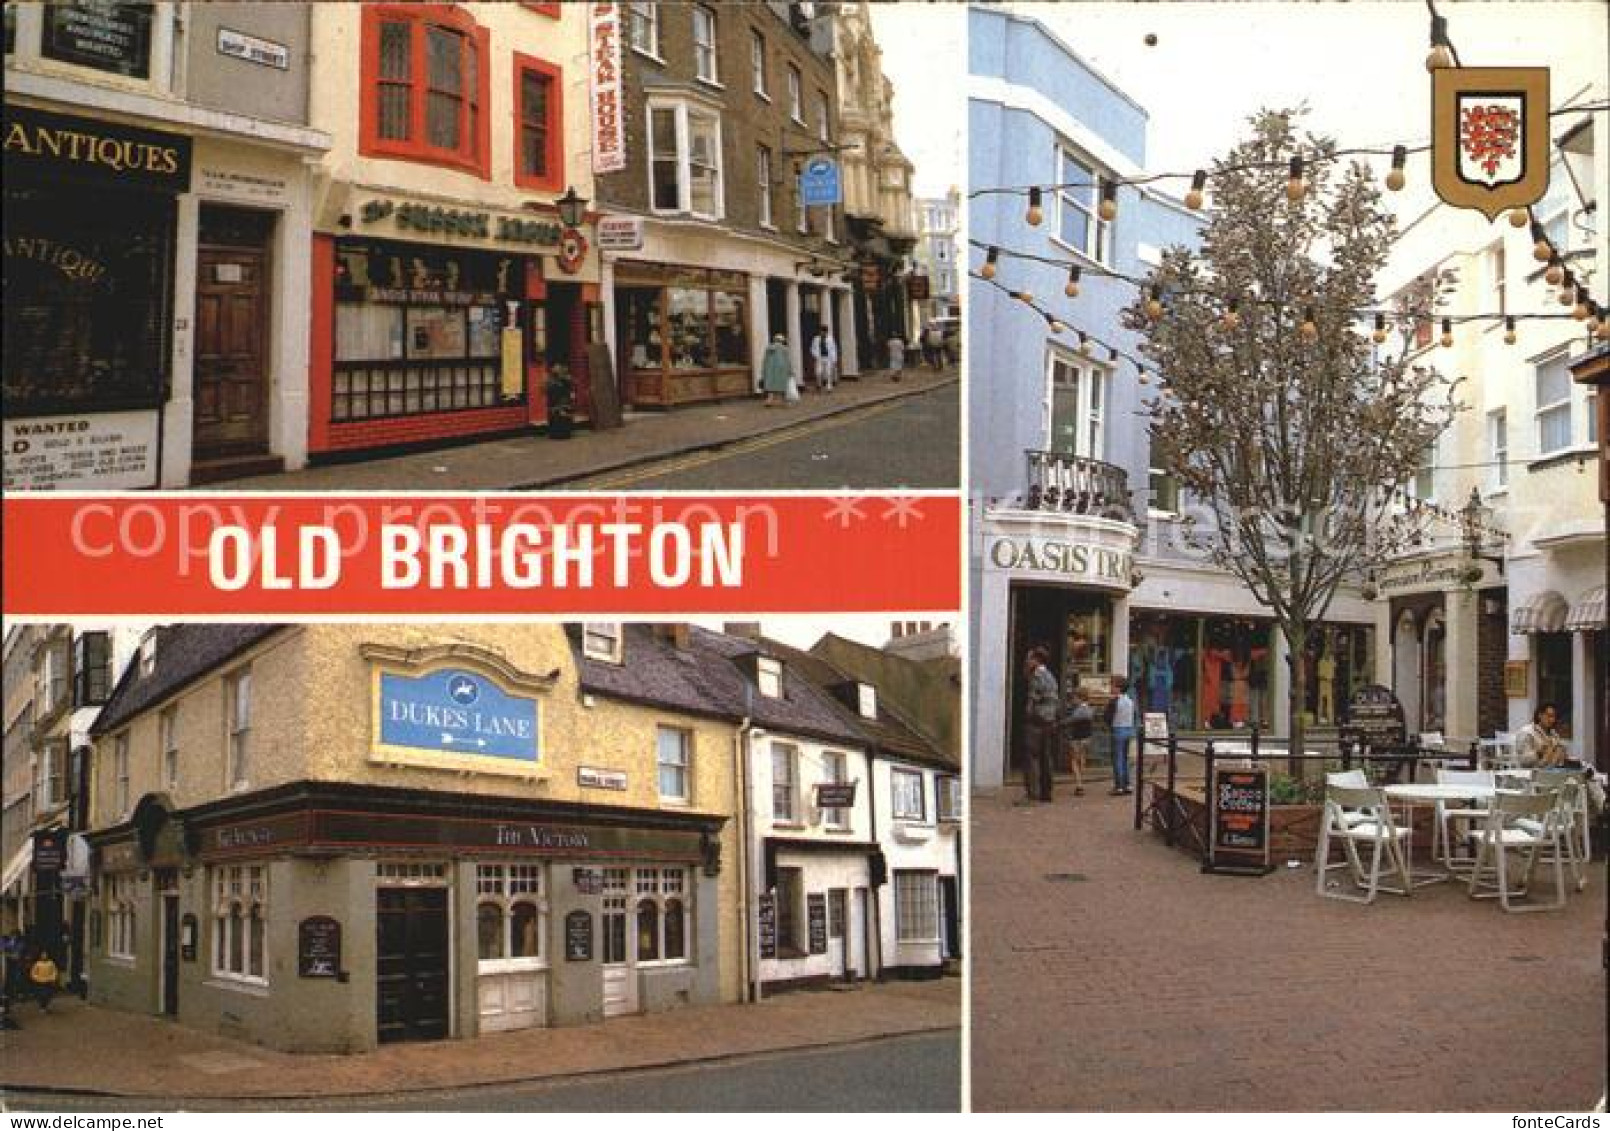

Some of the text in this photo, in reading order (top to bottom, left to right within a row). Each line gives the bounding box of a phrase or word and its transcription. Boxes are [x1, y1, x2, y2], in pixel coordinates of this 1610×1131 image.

[3, 121, 179, 174] ANTIQUES
[13, 420, 91, 436] WANTED
[991, 537, 1090, 573] OASIS
[390, 699, 531, 739] DUKES LANE
